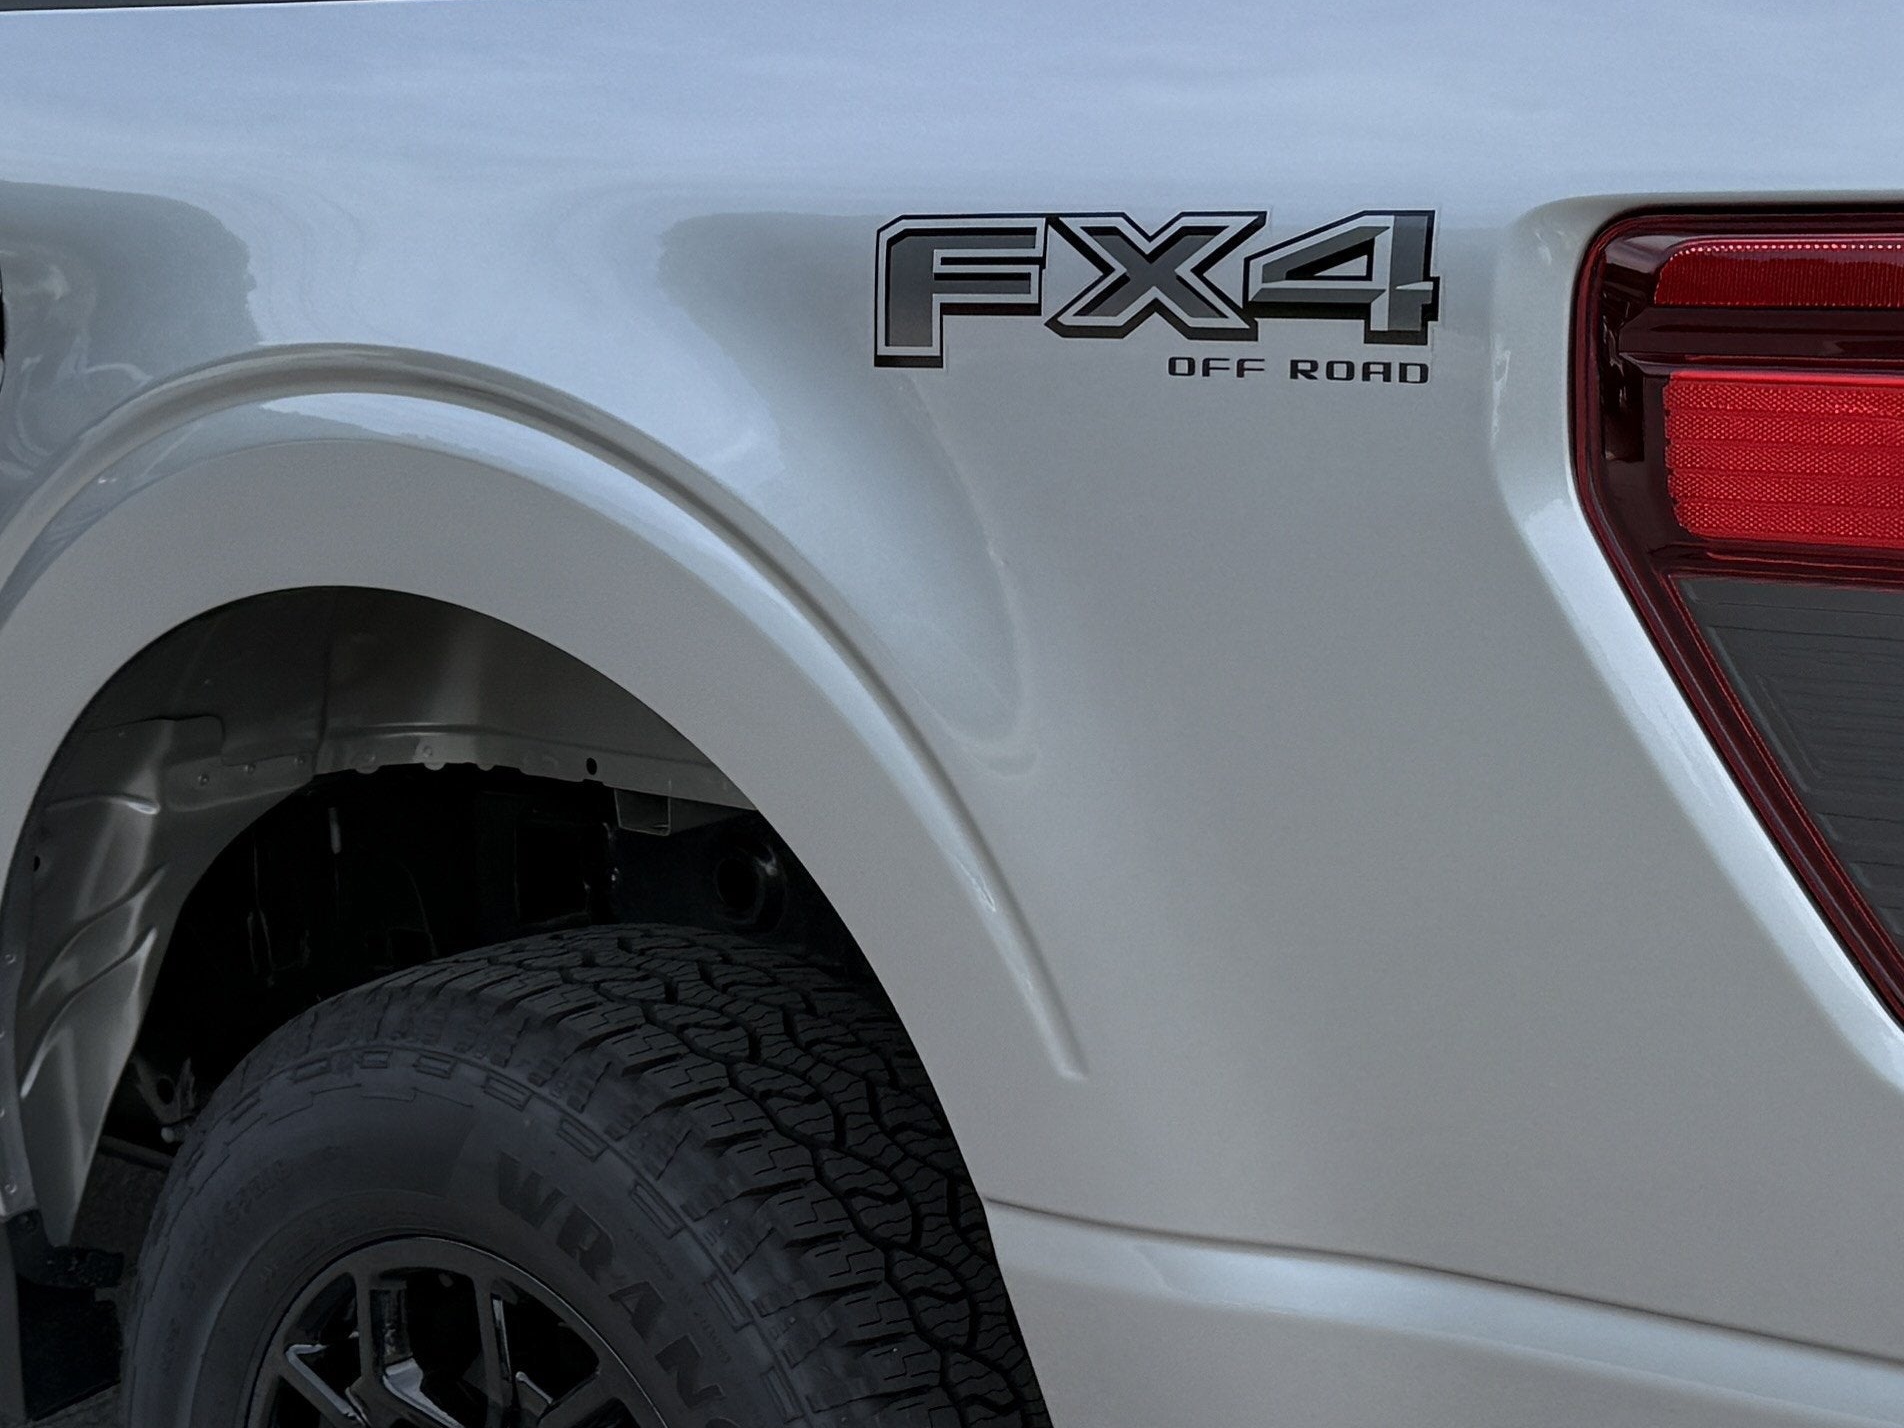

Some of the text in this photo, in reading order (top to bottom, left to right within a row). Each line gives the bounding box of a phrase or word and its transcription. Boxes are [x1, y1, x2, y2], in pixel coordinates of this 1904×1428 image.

[873, 210, 1441, 369] FX4
[1168, 356, 1429, 385] OFF ROAD
